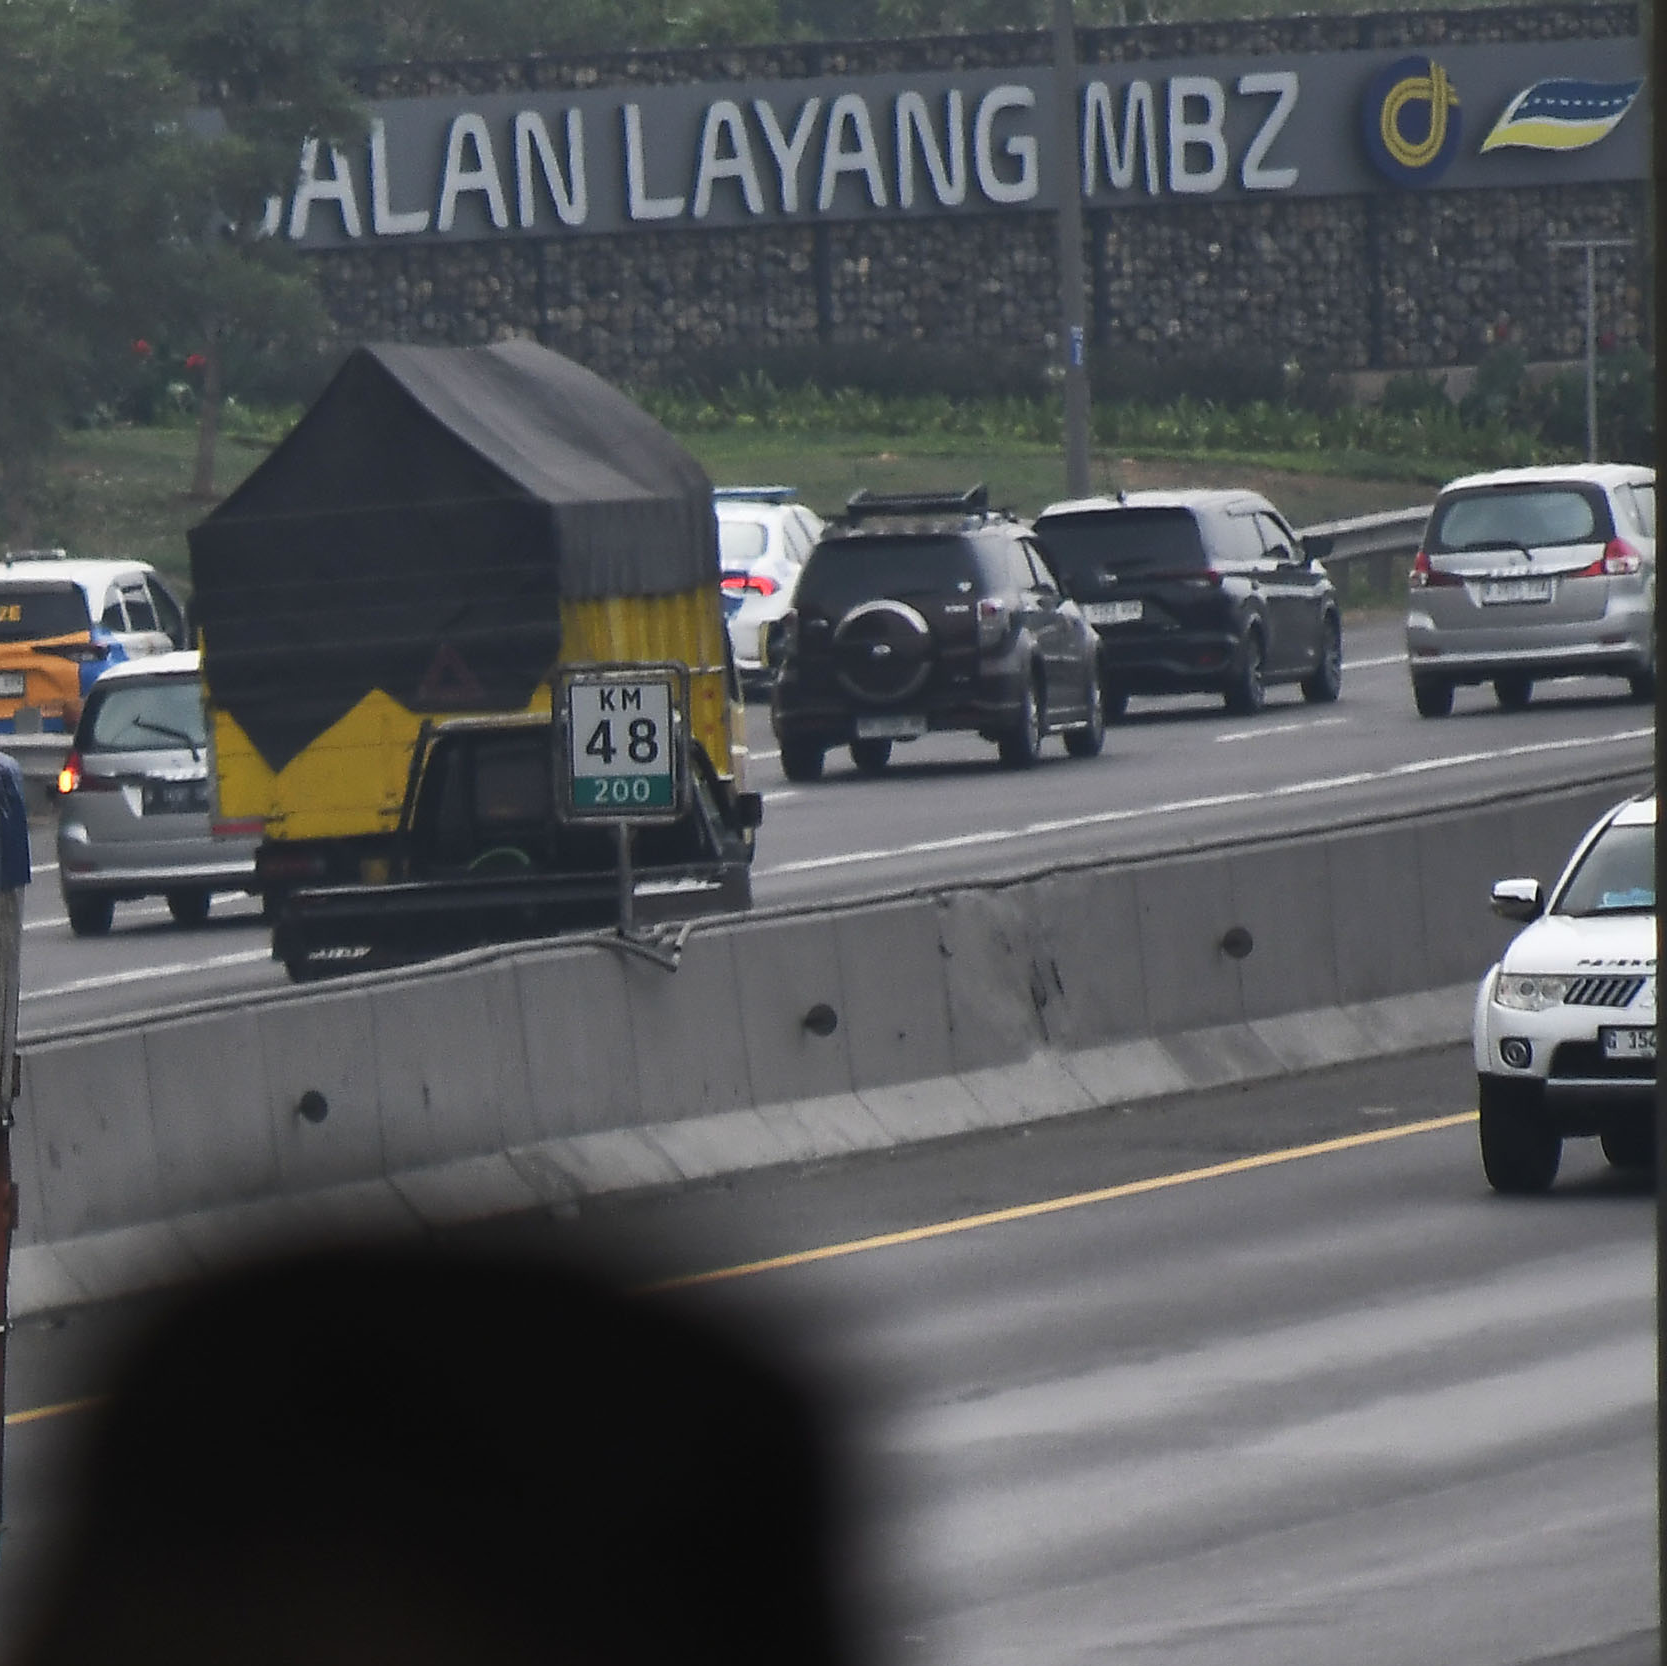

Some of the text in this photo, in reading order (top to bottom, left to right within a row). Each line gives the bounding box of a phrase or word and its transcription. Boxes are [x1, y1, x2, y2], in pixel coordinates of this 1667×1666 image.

[622, 84, 1038, 220] LAYANG
[1082, 71, 1299, 196] MBZ
[599, 688, 642, 711] KM
[586, 718, 659, 764] 48
[594, 777, 651, 802] 200
